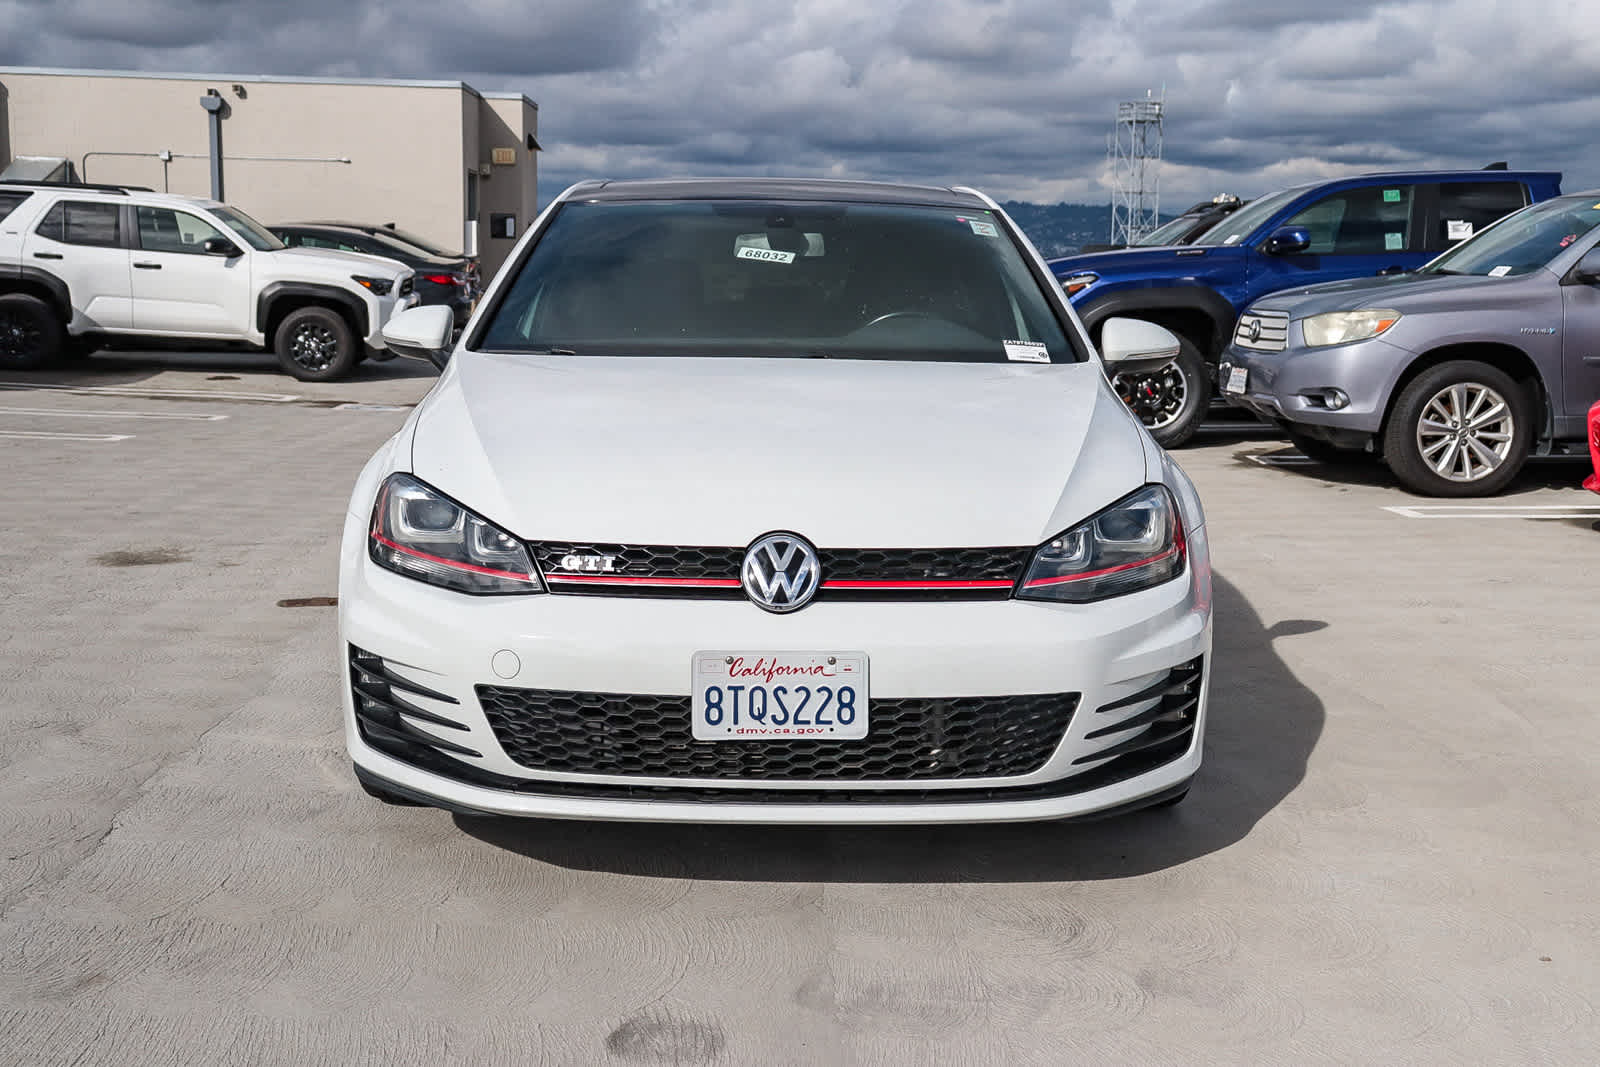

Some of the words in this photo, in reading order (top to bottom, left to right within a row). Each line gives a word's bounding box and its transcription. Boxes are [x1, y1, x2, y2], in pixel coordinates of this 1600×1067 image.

[745, 250, 788, 261] 68032
[561, 555, 616, 571] GTI
[746, 538, 815, 605] VW
[729, 657, 836, 683] California
[704, 686, 856, 726] 8TQS228
[736, 727, 825, 735] dmv.ca.gov
